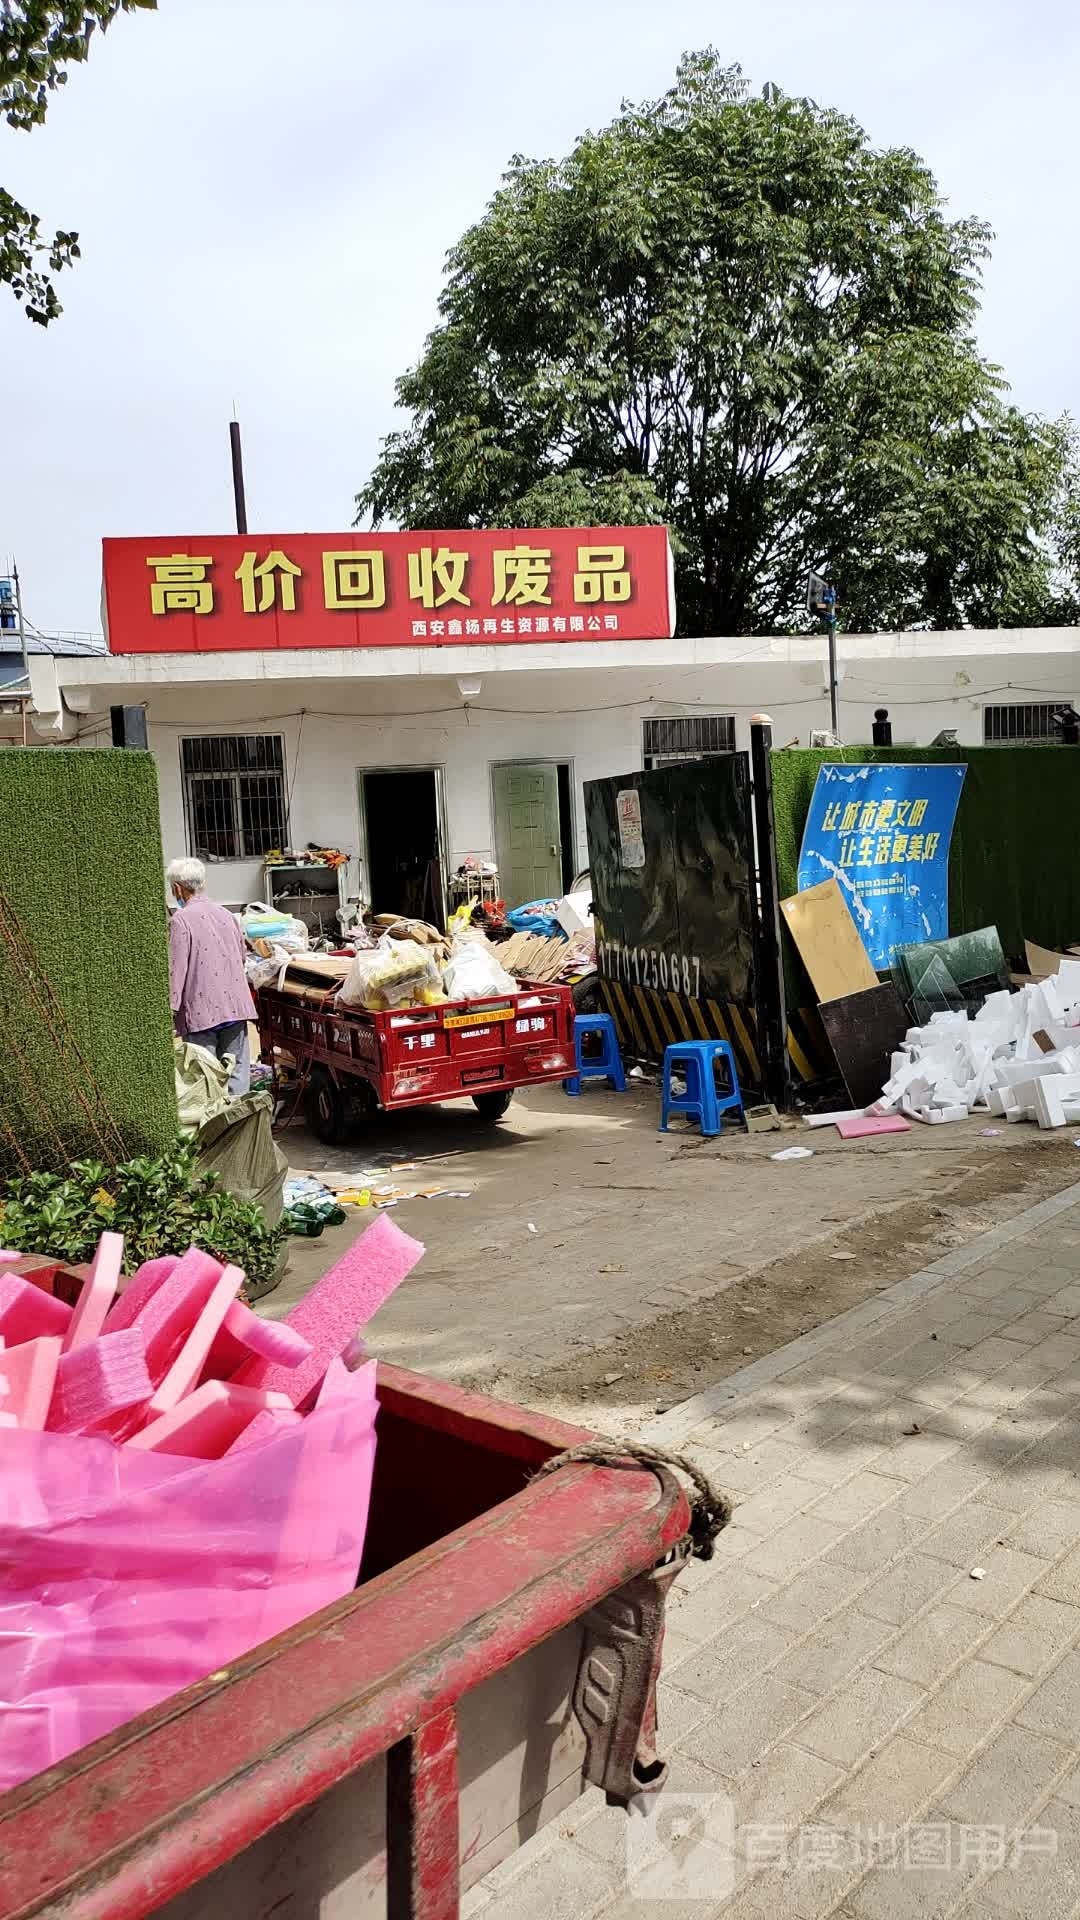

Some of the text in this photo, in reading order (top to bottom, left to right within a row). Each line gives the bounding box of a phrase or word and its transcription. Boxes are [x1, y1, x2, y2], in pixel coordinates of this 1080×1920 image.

[146, 546, 631, 614] 高价回收废品
[412, 615, 618, 636] 西安鑫扬再生资源有限公司
[822, 799, 928, 831] 让城市更文明
[839, 832, 940, 867] 让生活更美好
[403, 1033, 436, 1050] 千里
